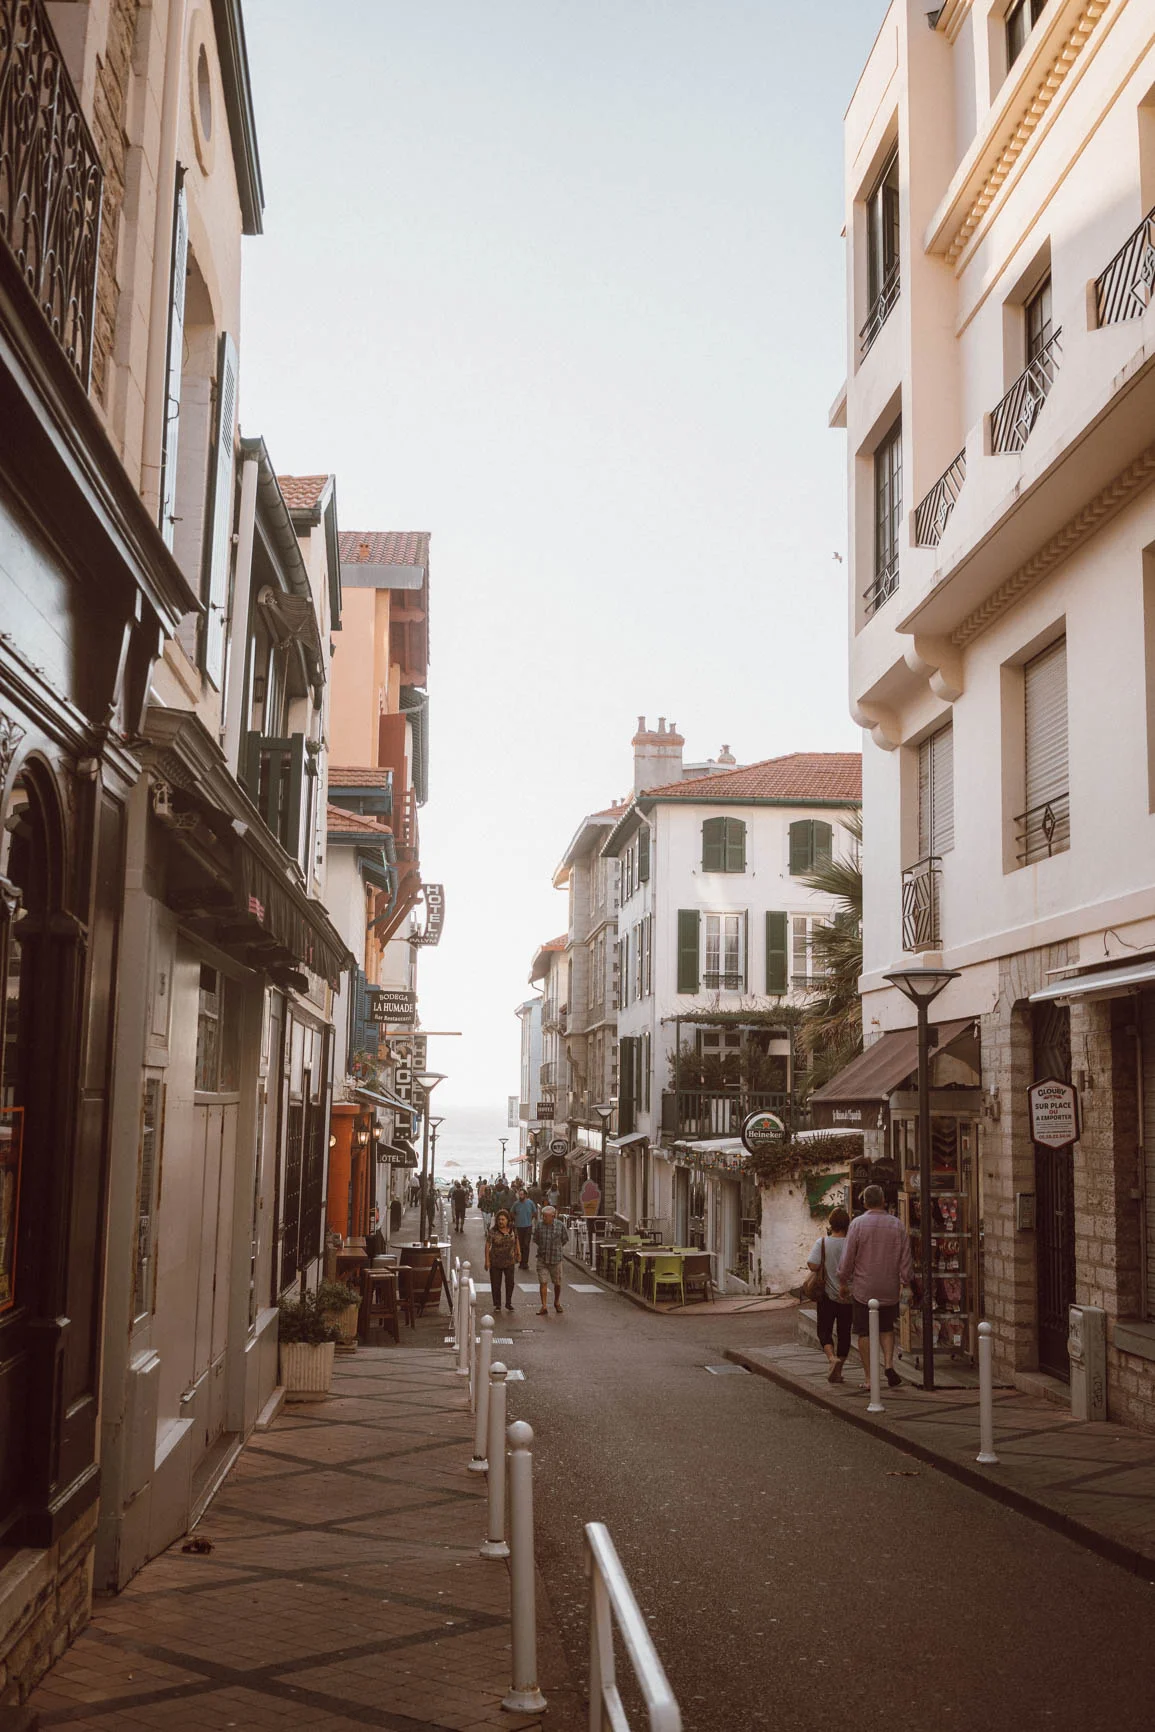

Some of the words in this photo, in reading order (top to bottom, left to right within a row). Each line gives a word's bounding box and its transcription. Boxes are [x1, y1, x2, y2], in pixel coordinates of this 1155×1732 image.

[426, 885, 442, 932] HOTEL
[373, 1002, 382, 1012] LA
[383, 1002, 414, 1013] HUMADE
[379, 993, 408, 1002] BODEGA
[394, 1053, 412, 1128] HOTL
